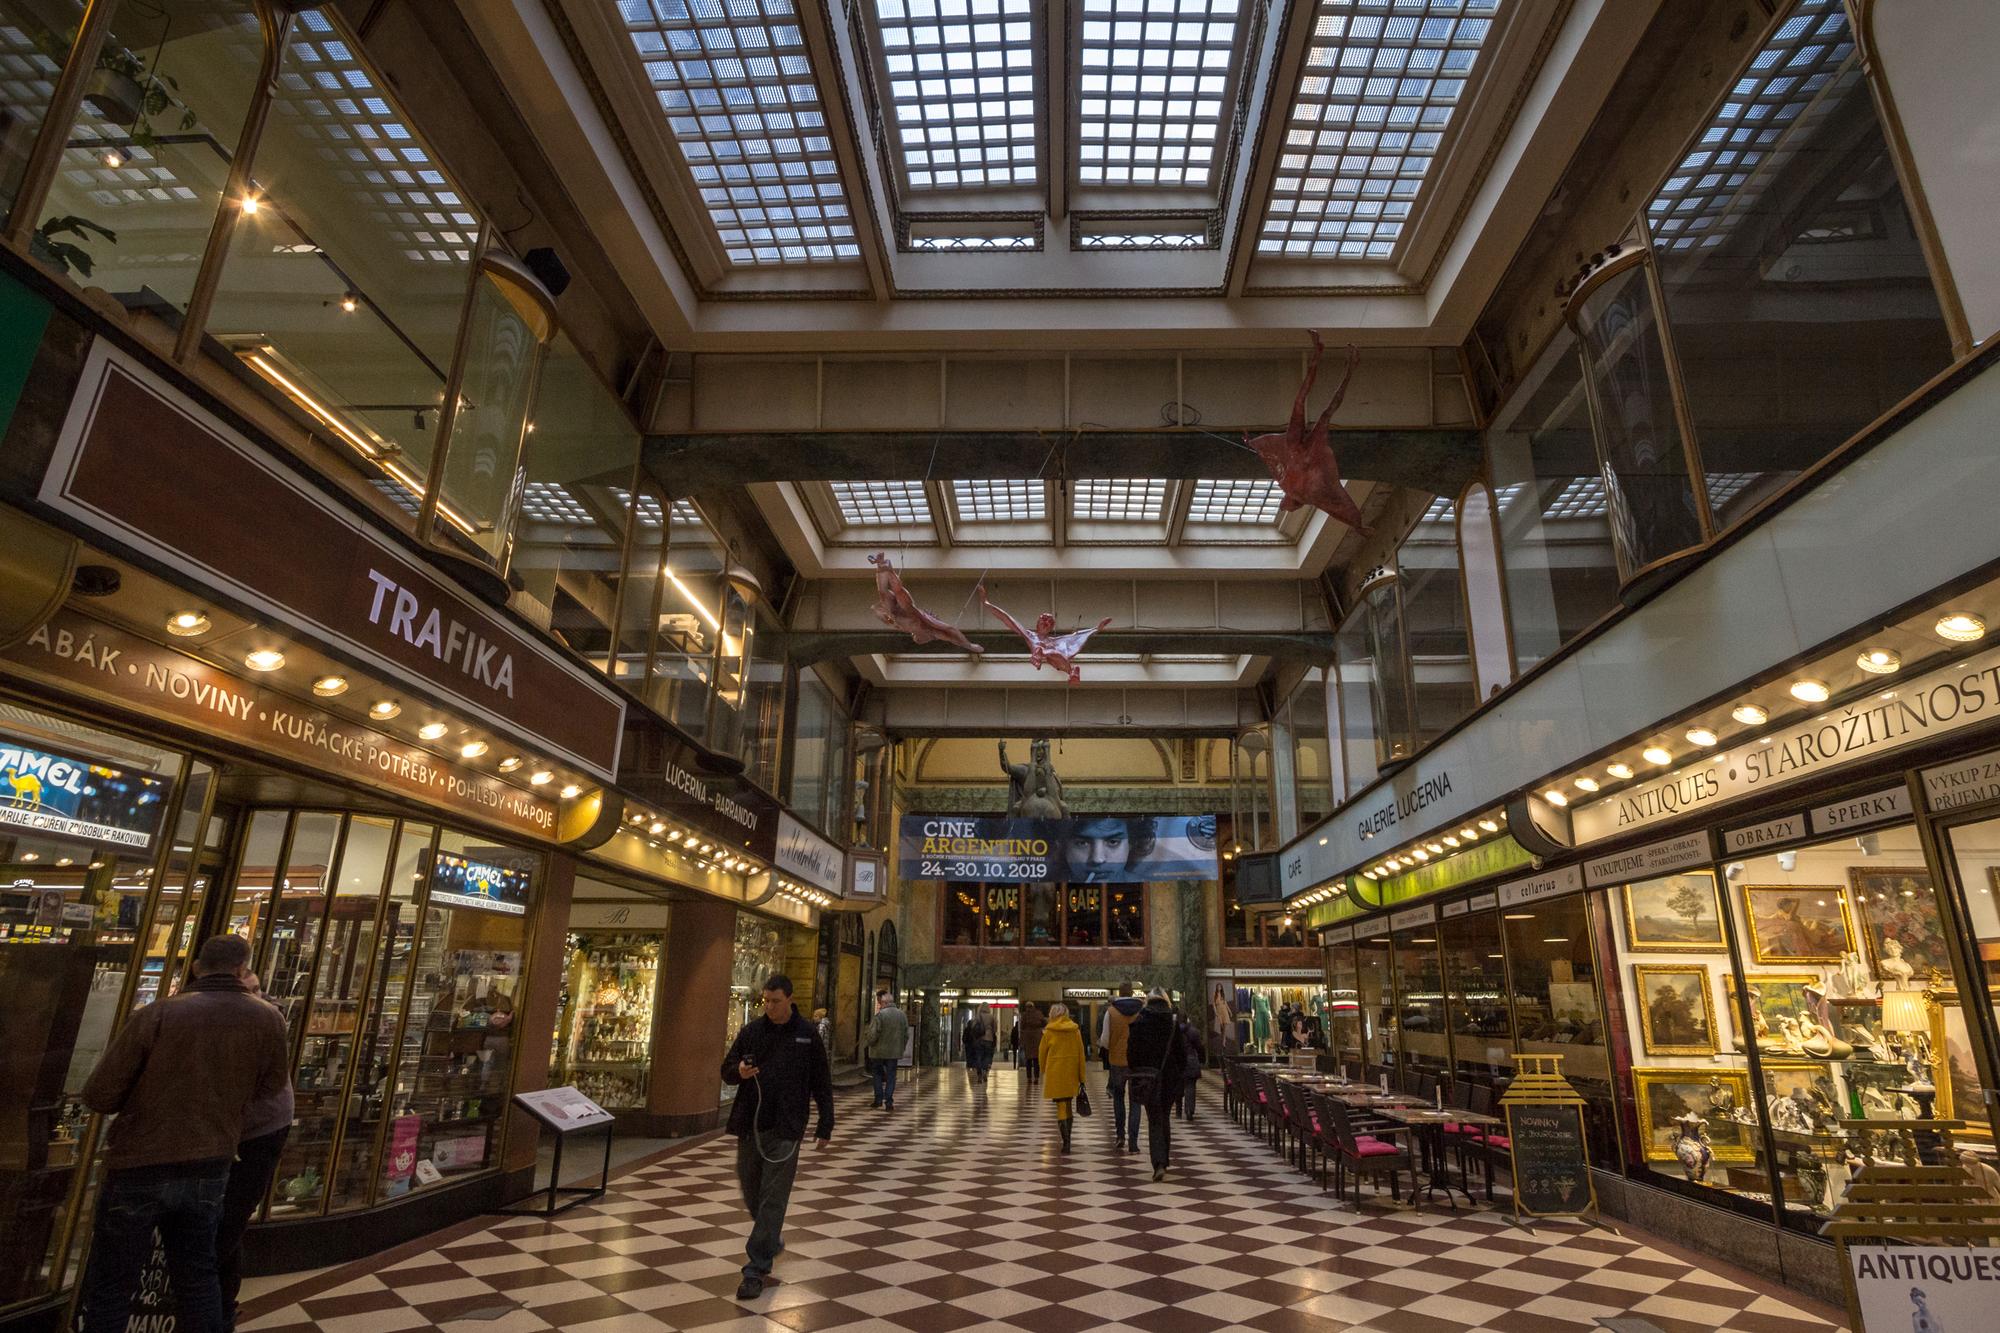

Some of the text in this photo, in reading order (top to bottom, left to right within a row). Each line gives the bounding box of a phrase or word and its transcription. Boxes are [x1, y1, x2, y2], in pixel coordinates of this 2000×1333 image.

[368, 568, 513, 699] TRAFIKA
[27, 624, 553, 828] ABÁK NOVINY KUŘÁCKÉ POTŘEBY POHLEDY NÁPOJE
[1618, 665, 2000, 826] ANTIQUES STAROŽITNOST
[0, 749, 82, 795] AMEL
[1928, 768, 1979, 790] VÝKUP
[665, 761, 706, 803] LUCERNA
[715, 792, 758, 831] BARRANDOV
[1358, 771, 1453, 841] GALERIE LUCERNA
[1828, 794, 1898, 826] ŠPERKY
[1935, 783, 2000, 811] PŘÍJEM D
[923, 821, 976, 838] CINE
[1735, 821, 1793, 847] OBRAZY
[922, 837, 1049, 856] ARGENTINO
[983, 863, 1005, 877] 10.
[1008, 863, 1048, 878] 2019
[1593, 854, 1644, 878] VYKUPUJEME
[1520, 880, 1556, 897] cellarius
